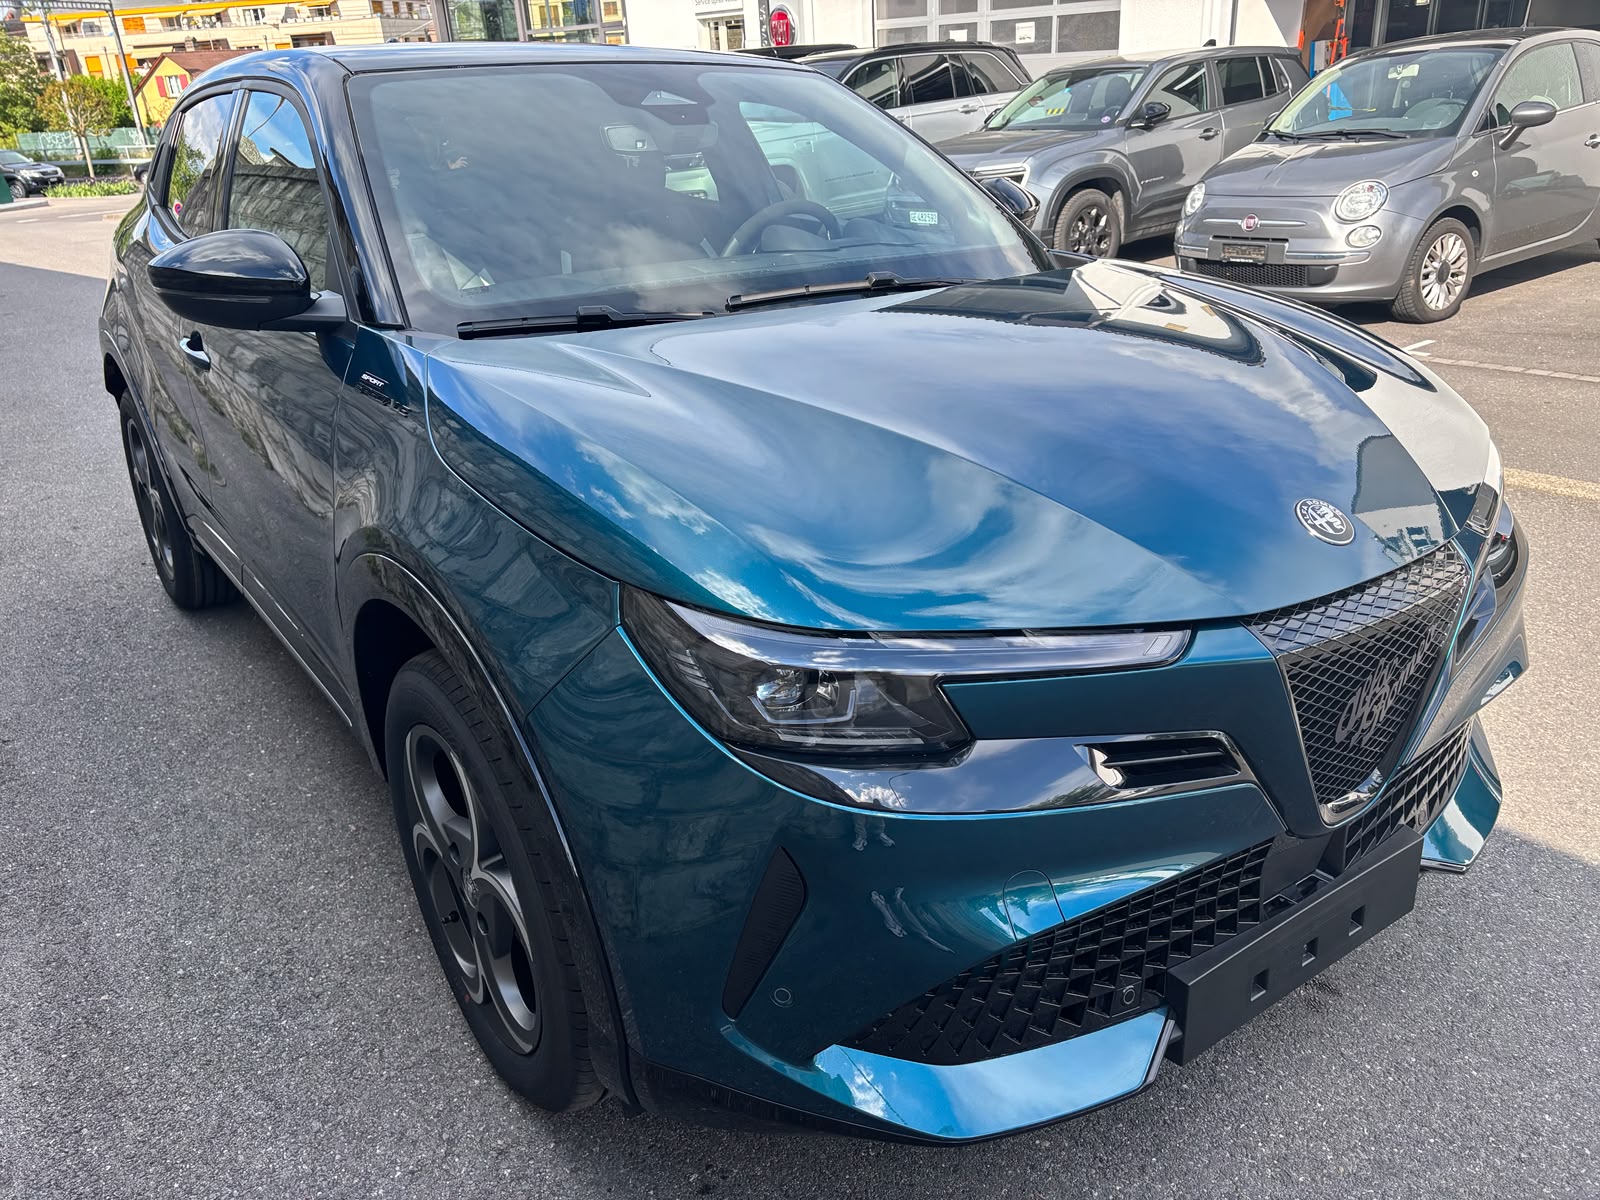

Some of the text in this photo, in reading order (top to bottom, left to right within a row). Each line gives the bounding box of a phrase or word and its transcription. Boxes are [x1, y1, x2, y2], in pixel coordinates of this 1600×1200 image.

[771, 19, 788, 43] FIAT
[361, 373, 385, 387] SPORT
[1301, 500, 1343, 525] ALFA ROMEO
